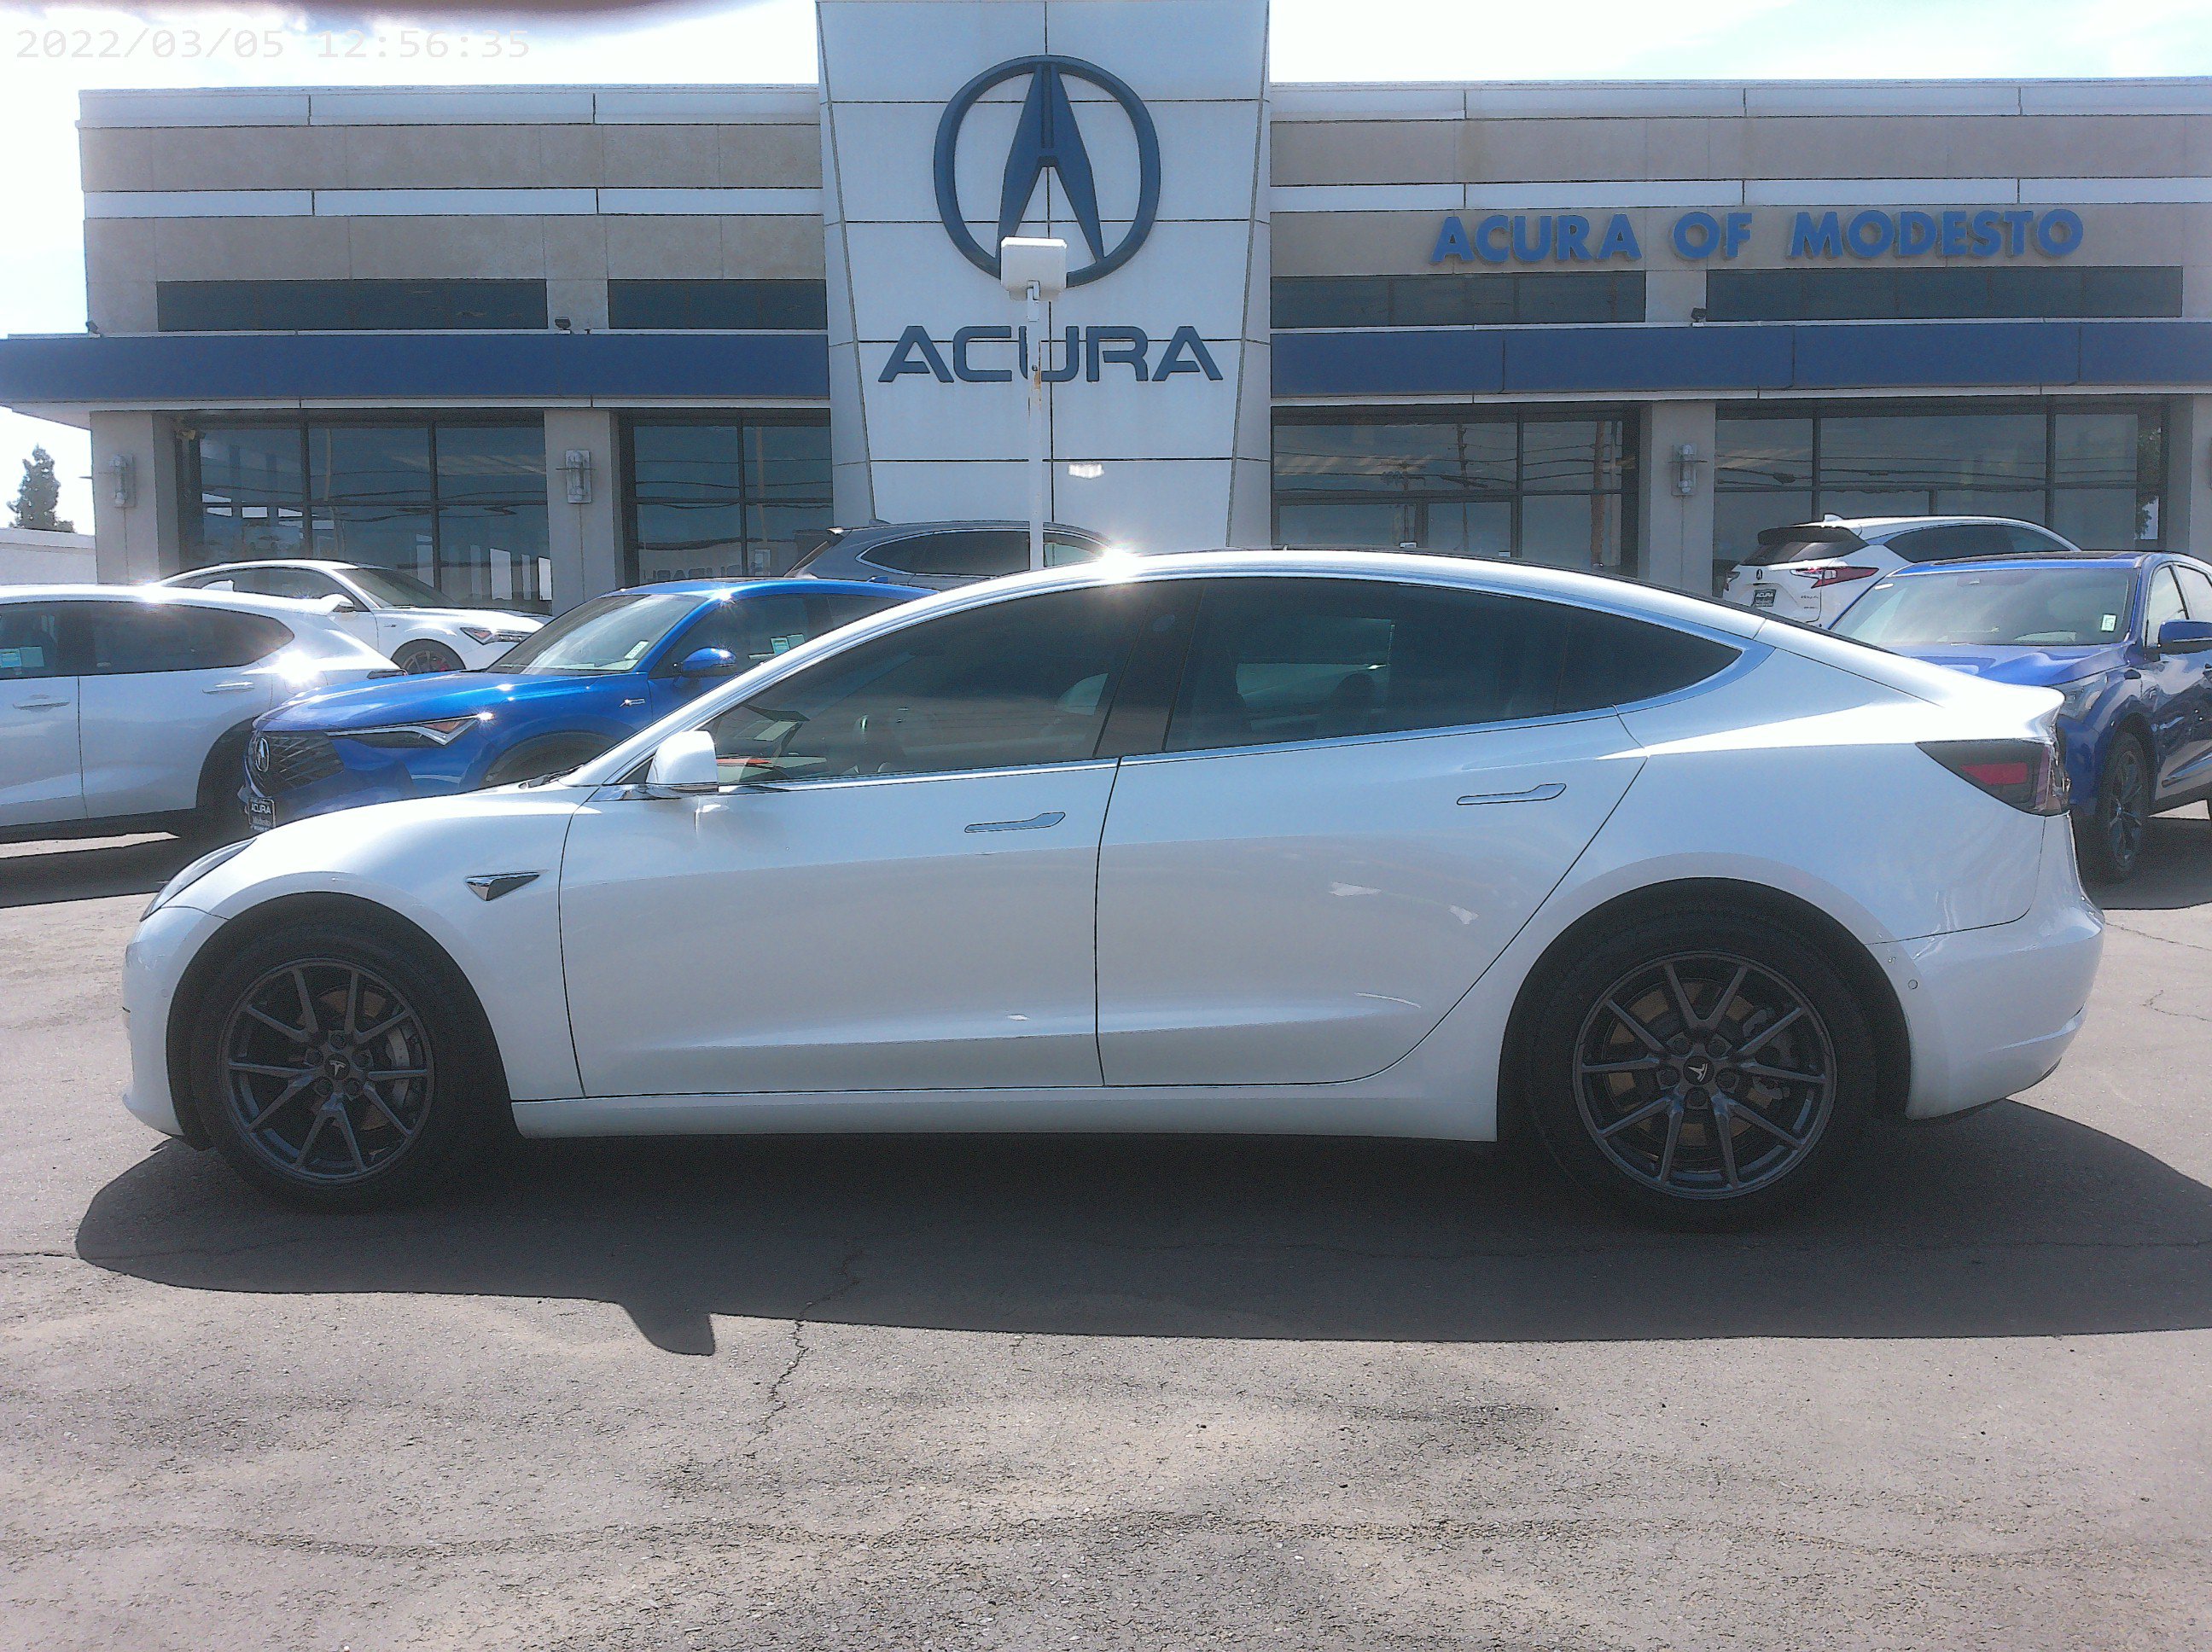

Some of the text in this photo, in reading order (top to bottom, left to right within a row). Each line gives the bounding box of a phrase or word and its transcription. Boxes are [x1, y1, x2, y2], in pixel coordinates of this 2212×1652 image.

[1431, 207, 2085, 264] ACURA OF MODESTO
[877, 324, 1224, 383] ACURA
